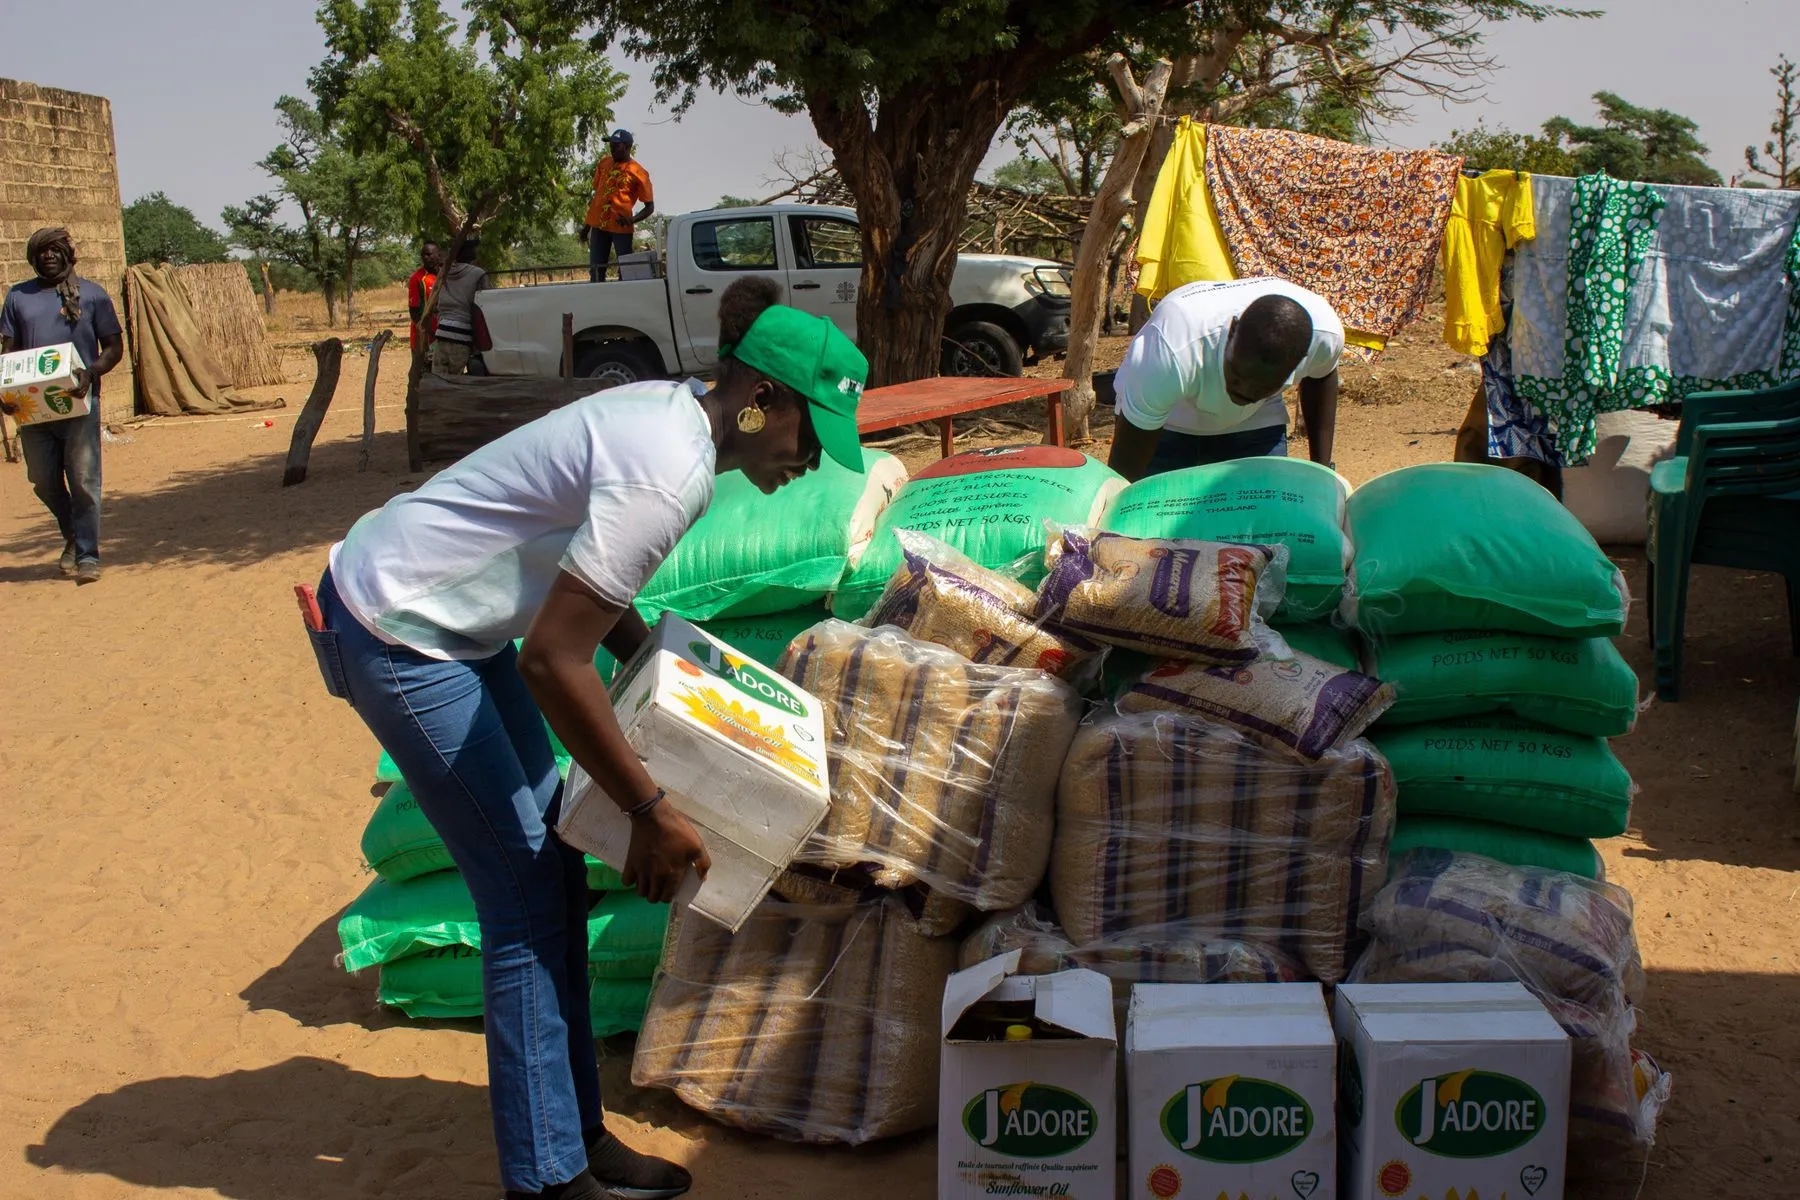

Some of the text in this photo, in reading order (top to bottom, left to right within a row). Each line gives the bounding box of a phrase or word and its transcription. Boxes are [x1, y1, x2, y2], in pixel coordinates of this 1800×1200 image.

[932, 481, 1014, 498] RIZ BLANC
[974, 472, 1035, 481] BROKEN
[1039, 478, 1075, 495] RICE
[912, 492, 1030, 511] 100% BRISURES
[1205, 504, 1258, 514] THAILAND
[900, 513, 1032, 532] OIDS NET 50 KGS
[755, 629, 785, 642] KGS
[1432, 647, 1579, 668] POIDS NET 50 KGS
[1423, 737, 1573, 759] POIDS NET 50 KGS
[976, 1161, 984, 1169] de
[985, 1181, 1070, 1197] Sunflower Oil
